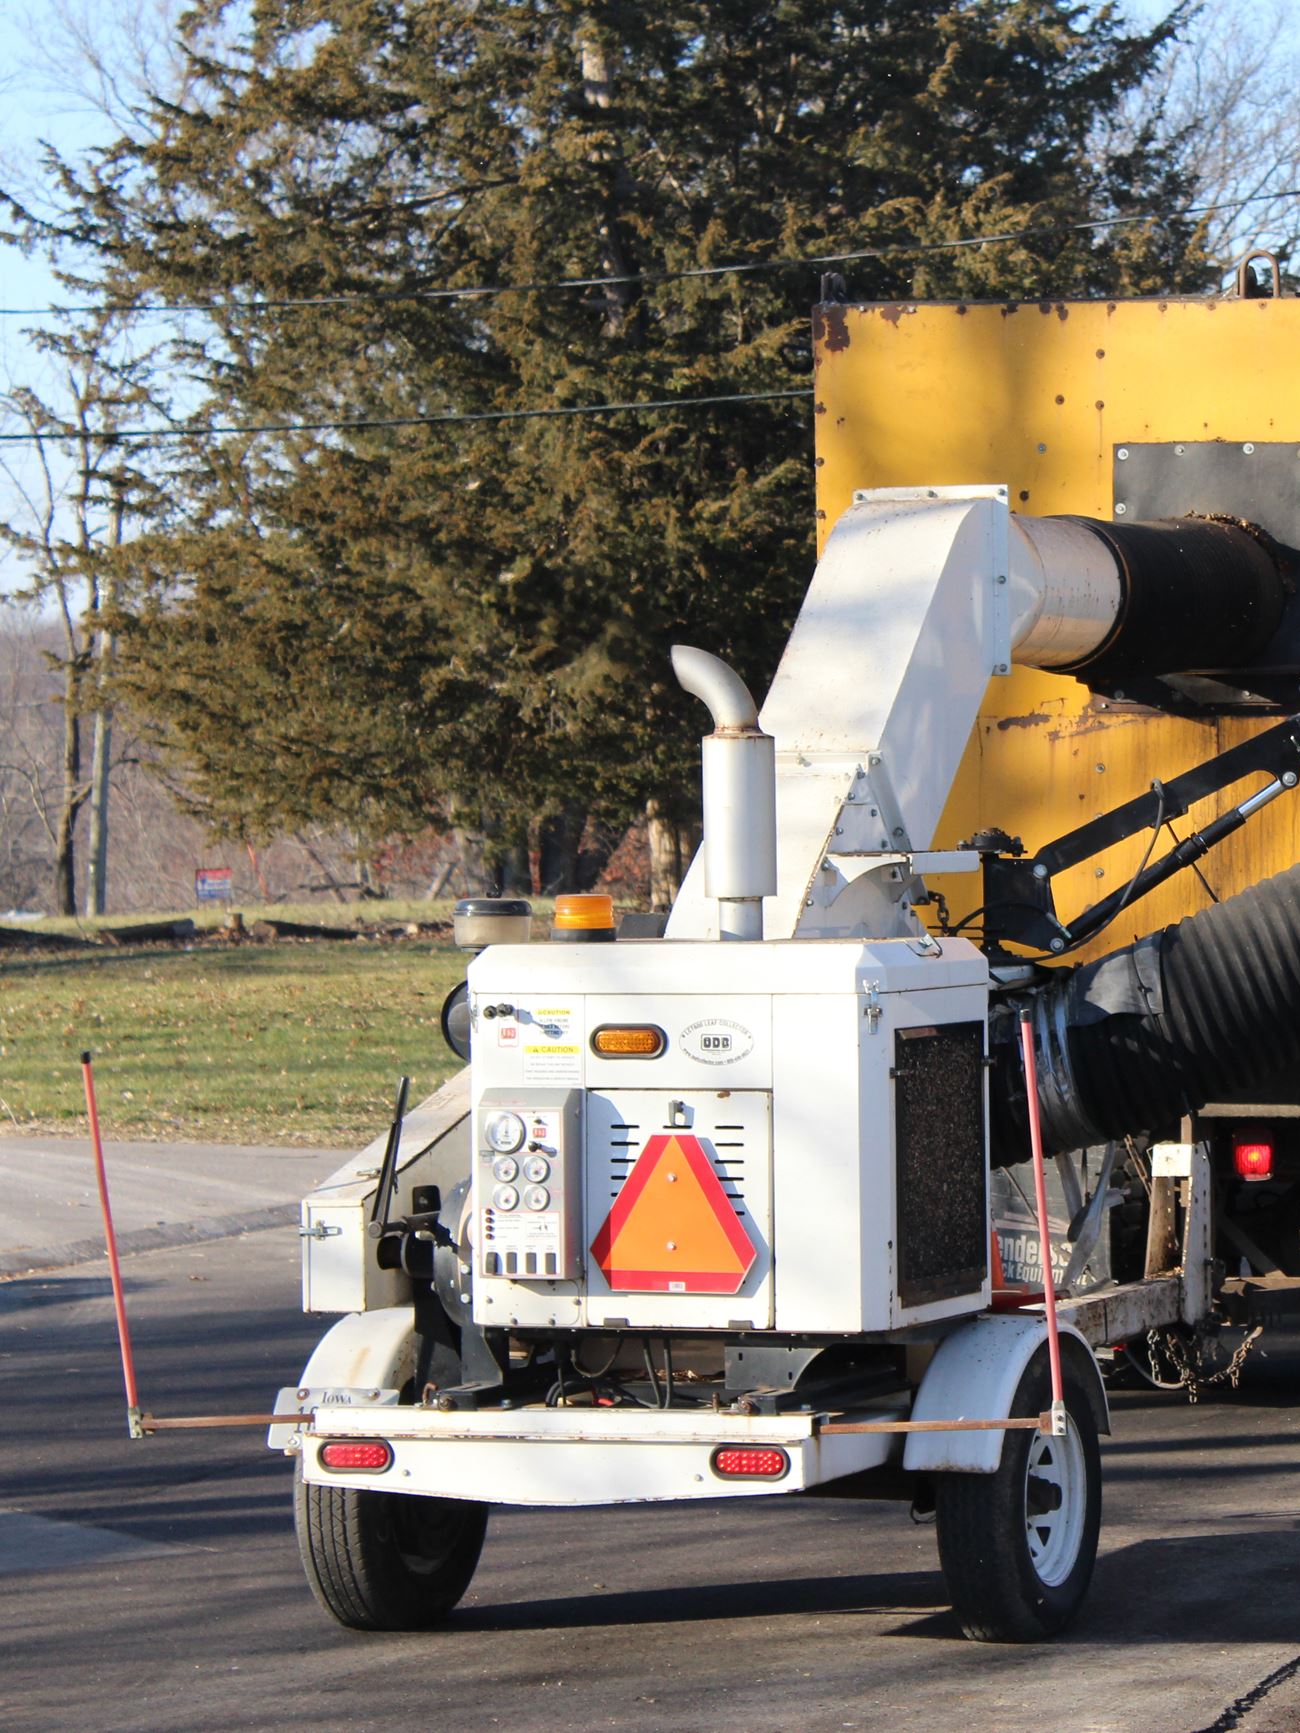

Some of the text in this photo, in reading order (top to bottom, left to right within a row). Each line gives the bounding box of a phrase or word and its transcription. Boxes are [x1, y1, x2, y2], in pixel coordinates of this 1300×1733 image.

[704, 1019, 717, 1027] LEAF
[703, 1036, 730, 1049] ODB
[541, 1046, 574, 1054] CAUTION
